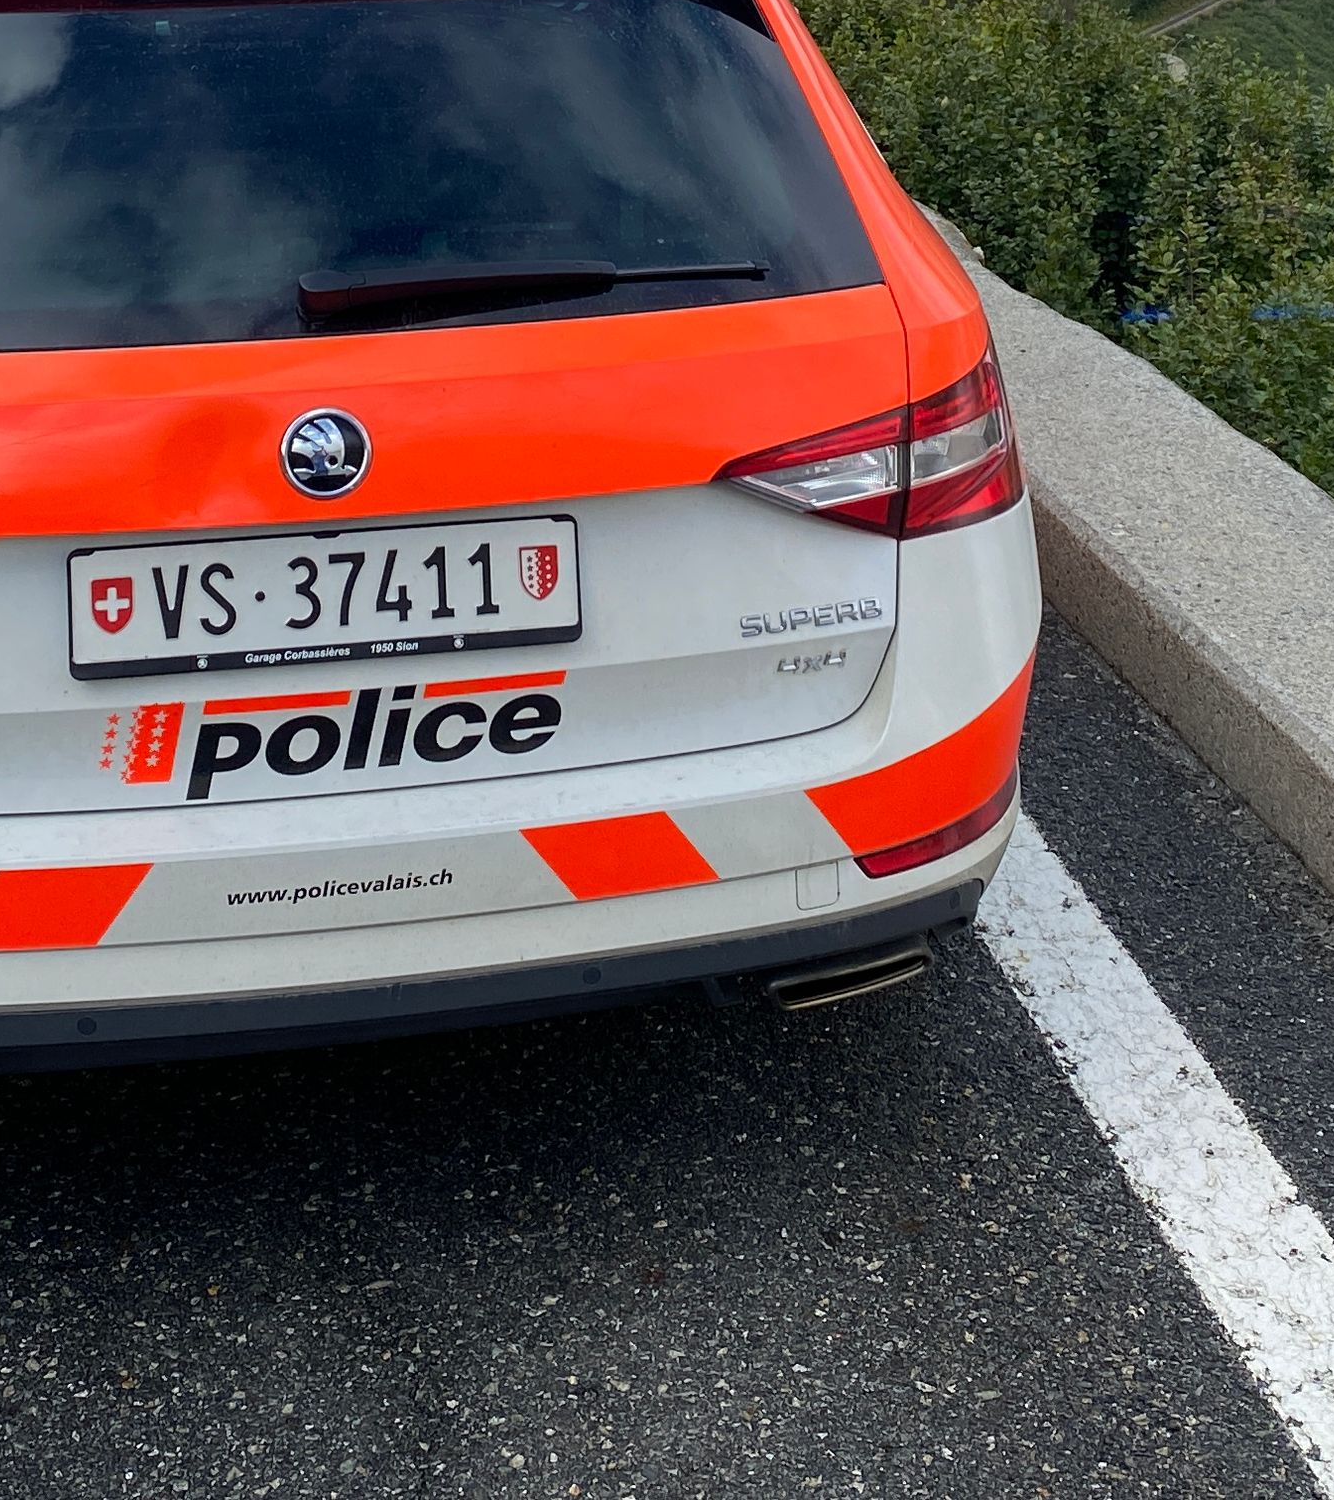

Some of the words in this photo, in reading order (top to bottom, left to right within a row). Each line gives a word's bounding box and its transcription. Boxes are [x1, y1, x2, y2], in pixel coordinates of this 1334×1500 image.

[740, 597, 883, 637] SUPERB
[244, 652, 282, 664] Garage
[369, 643, 394, 654] 1950
[396, 641, 419, 652] Sion
[186, 684, 563, 801] police
[227, 868, 454, 906] www.policevalais.ch
